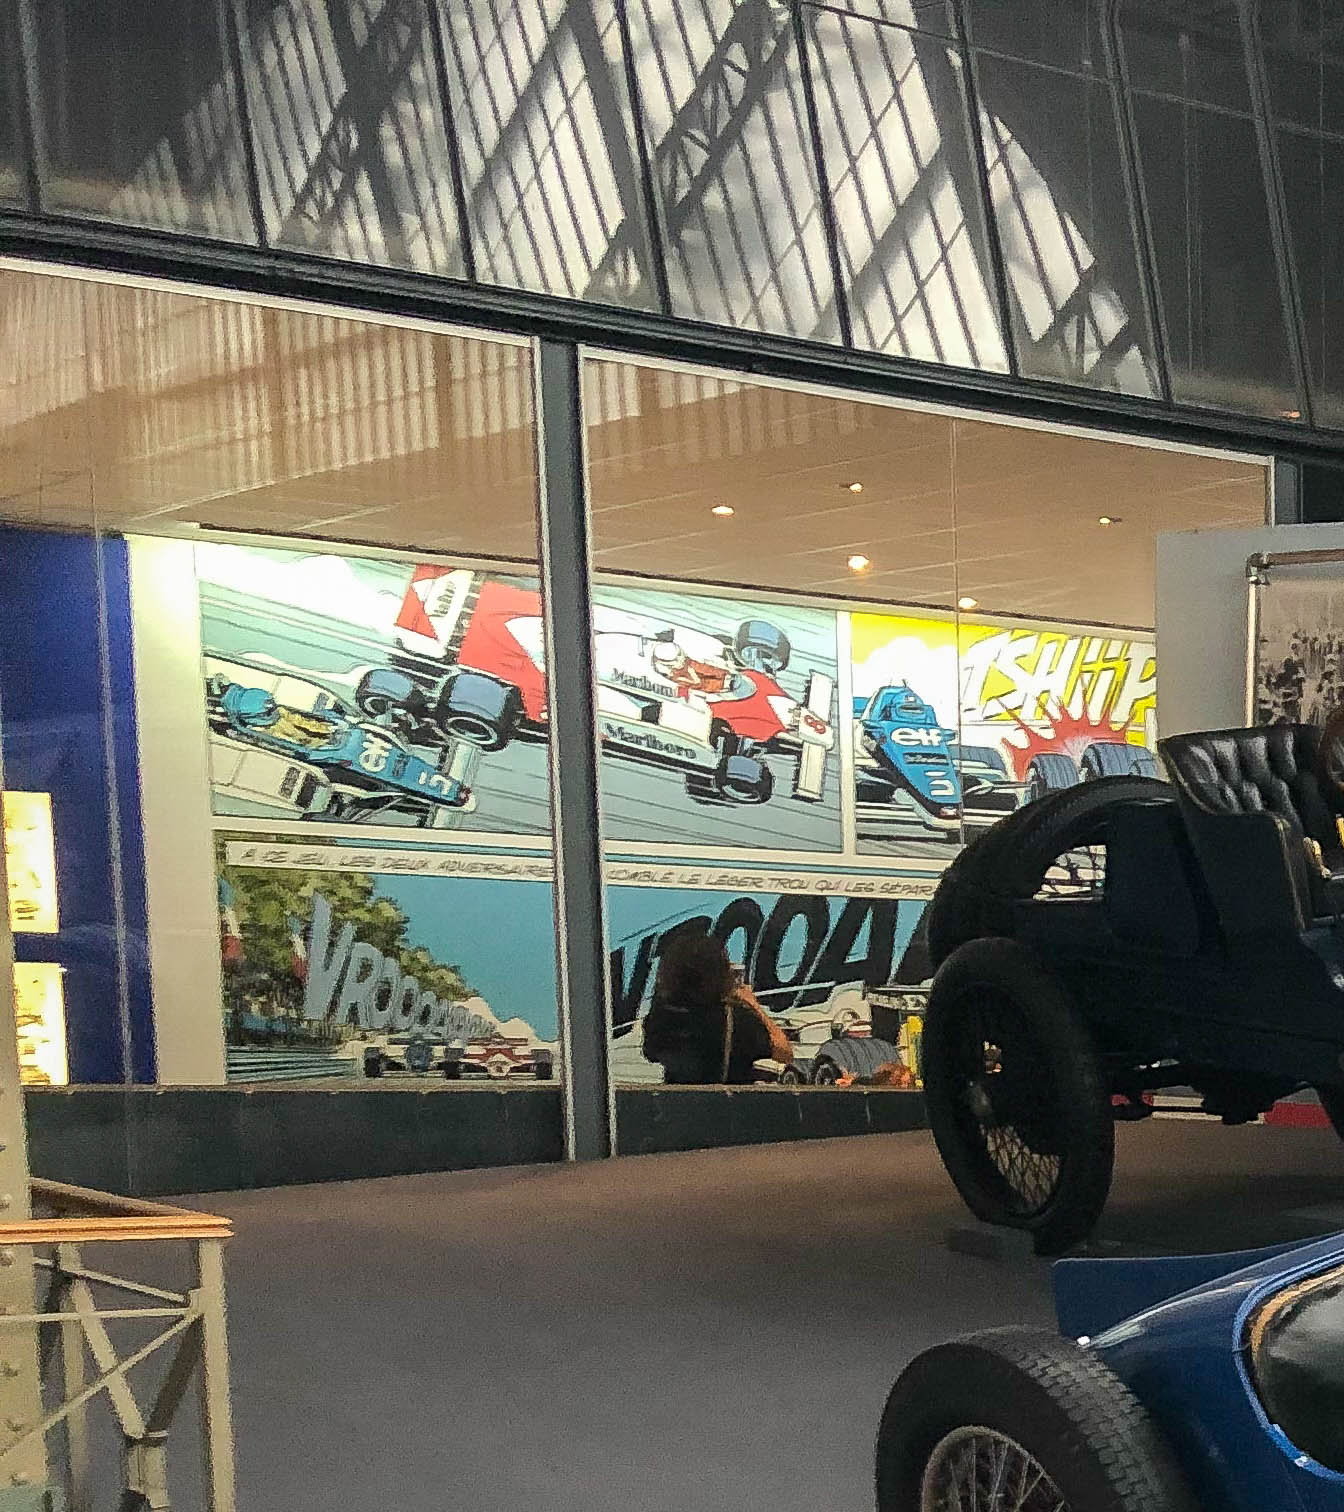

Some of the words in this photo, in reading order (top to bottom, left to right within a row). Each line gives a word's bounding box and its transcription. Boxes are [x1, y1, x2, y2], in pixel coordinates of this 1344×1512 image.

[678, 872, 701, 886] LE
[768, 876, 811, 891] TROU
[815, 878, 843, 893] QUI
[846, 880, 875, 894] LES
